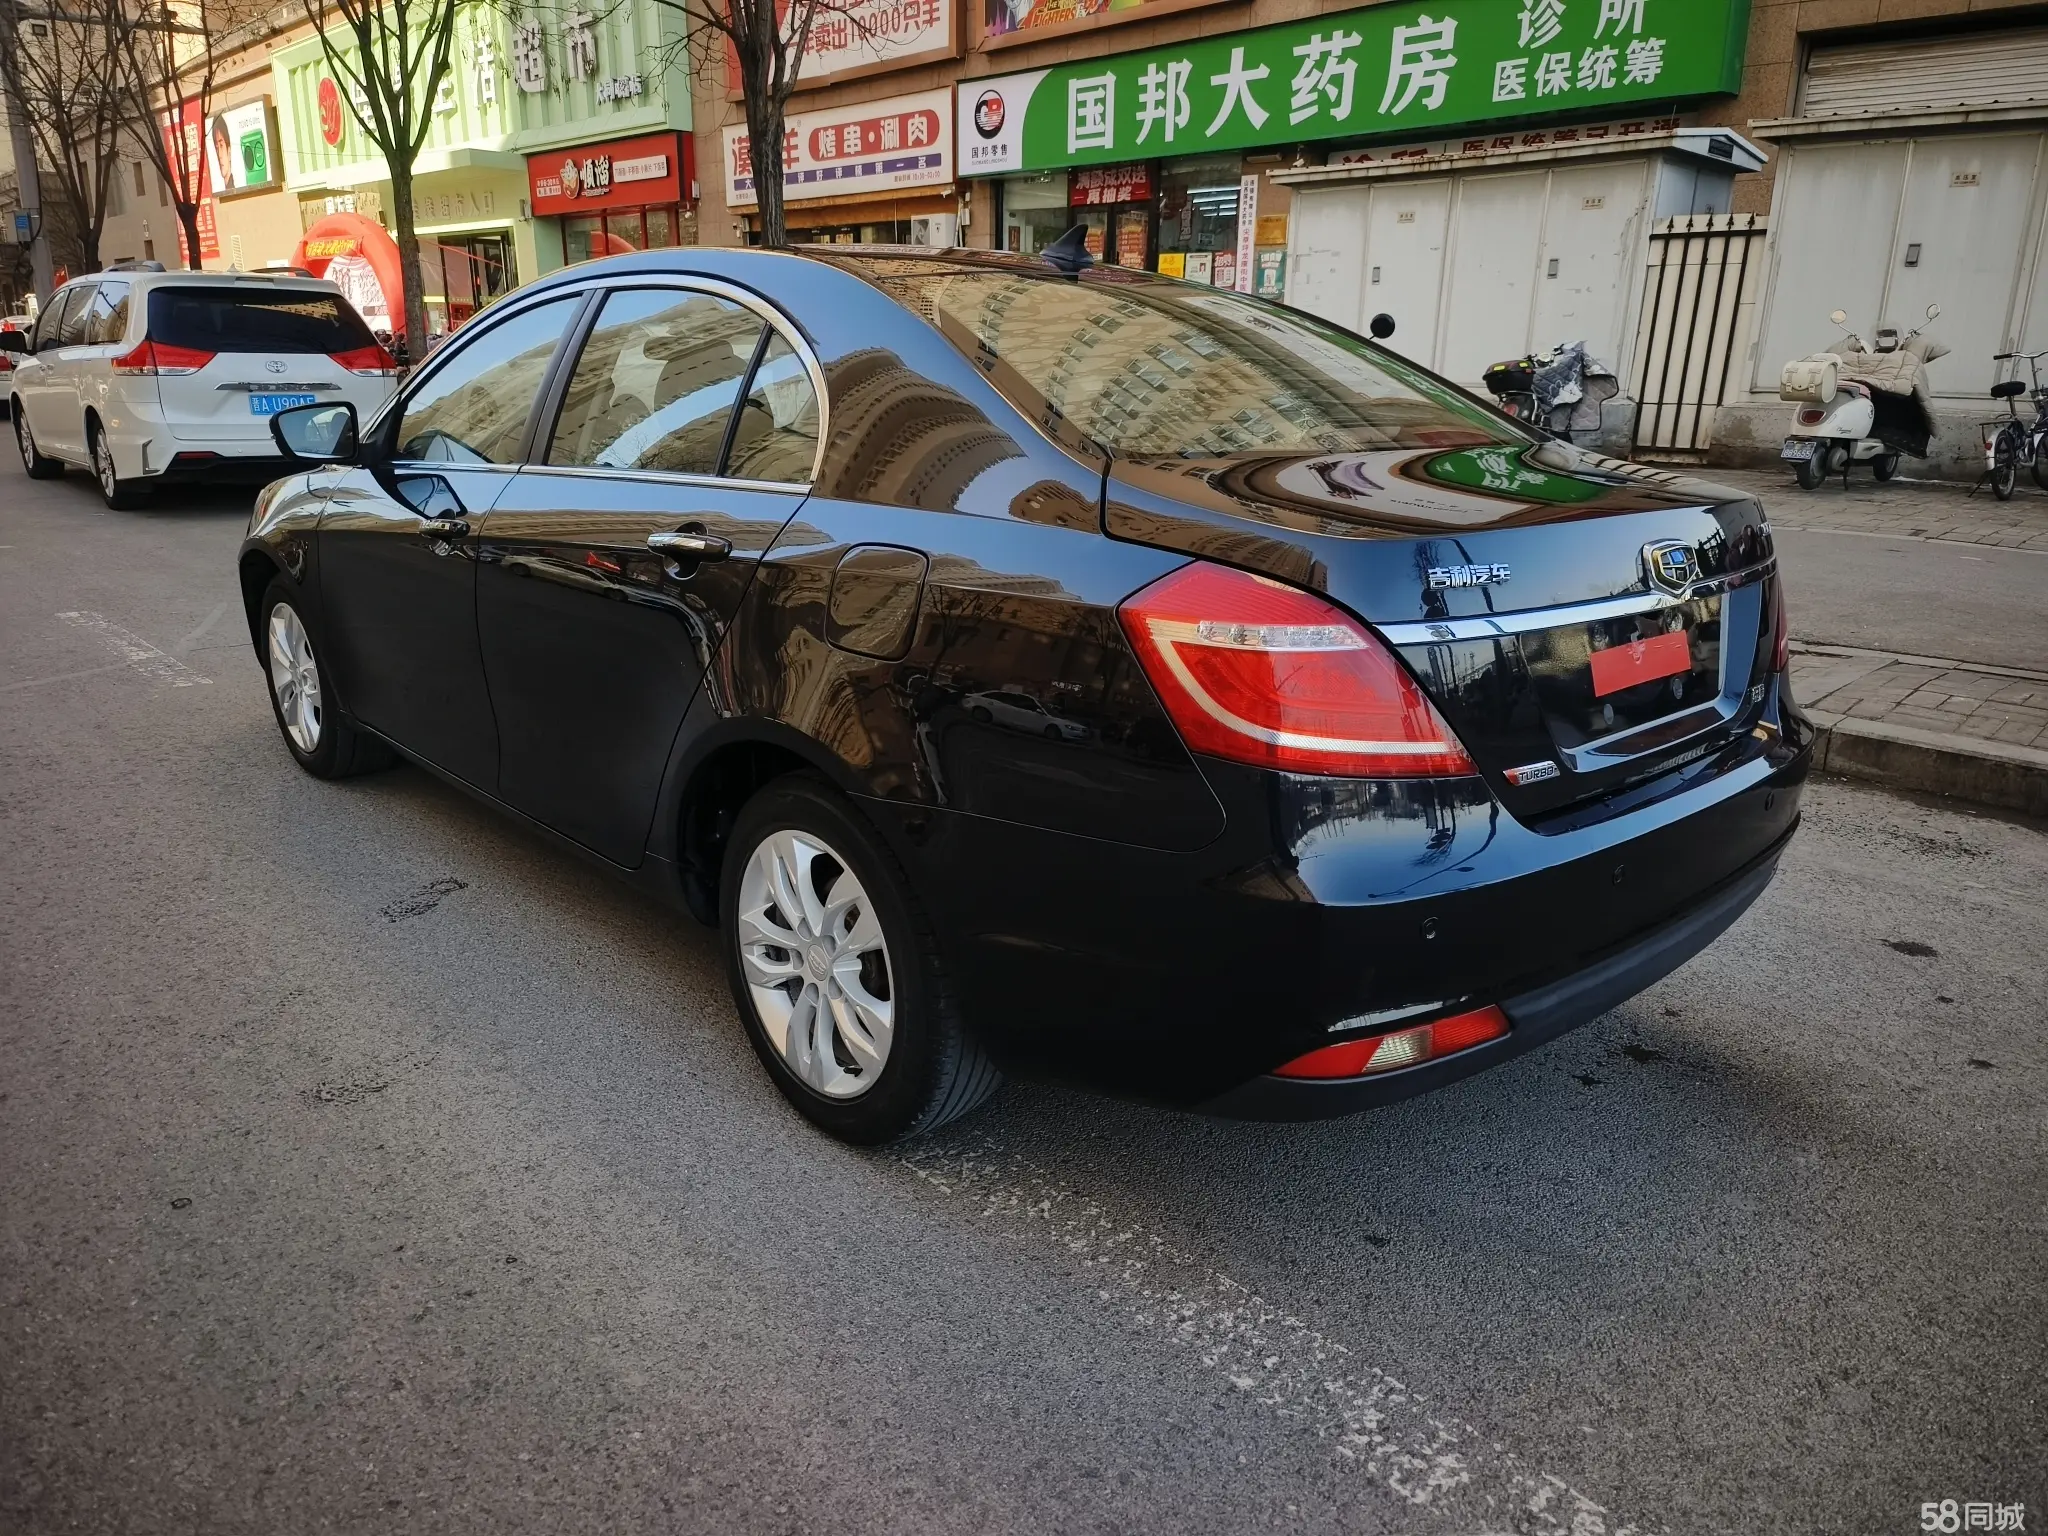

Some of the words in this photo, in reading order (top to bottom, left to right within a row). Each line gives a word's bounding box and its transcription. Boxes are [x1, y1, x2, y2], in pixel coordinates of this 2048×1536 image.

[1517, 0, 1648, 49] 诊所
[1067, 14, 1459, 154] 国邦大药房
[1492, 37, 1667, 103] 医保统筹
[971, 144, 1008, 159] 国邦零售
[745, 157, 927, 189] 大评好评榜第一名
[1427, 563, 1511, 590] 吉利汽车
[1518, 765, 1554, 782] TURBO
